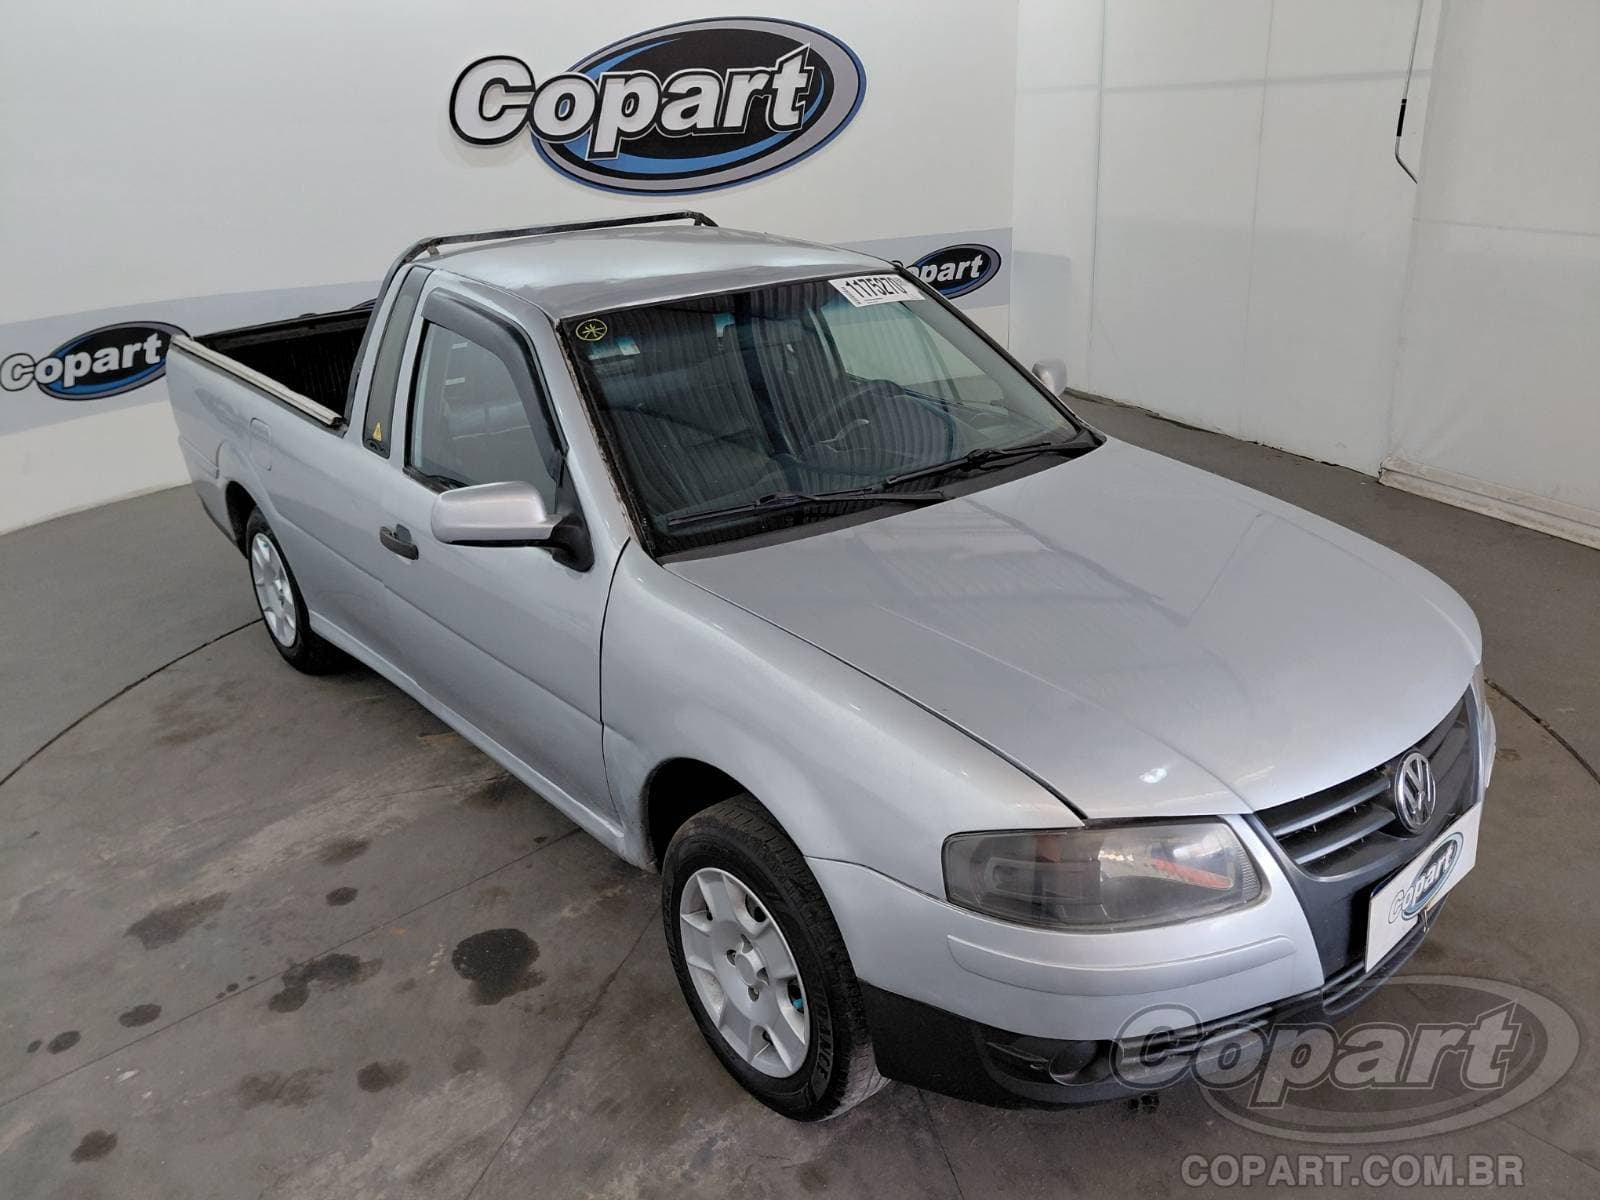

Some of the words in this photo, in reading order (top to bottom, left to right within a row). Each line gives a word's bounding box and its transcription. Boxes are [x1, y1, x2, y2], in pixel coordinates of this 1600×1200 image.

[449, 42, 814, 160] Copart
[845, 276, 907, 298] 1175270
[906, 254, 983, 283] part
[0, 332, 162, 391] Copart
[1388, 841, 1455, 924] Copart
